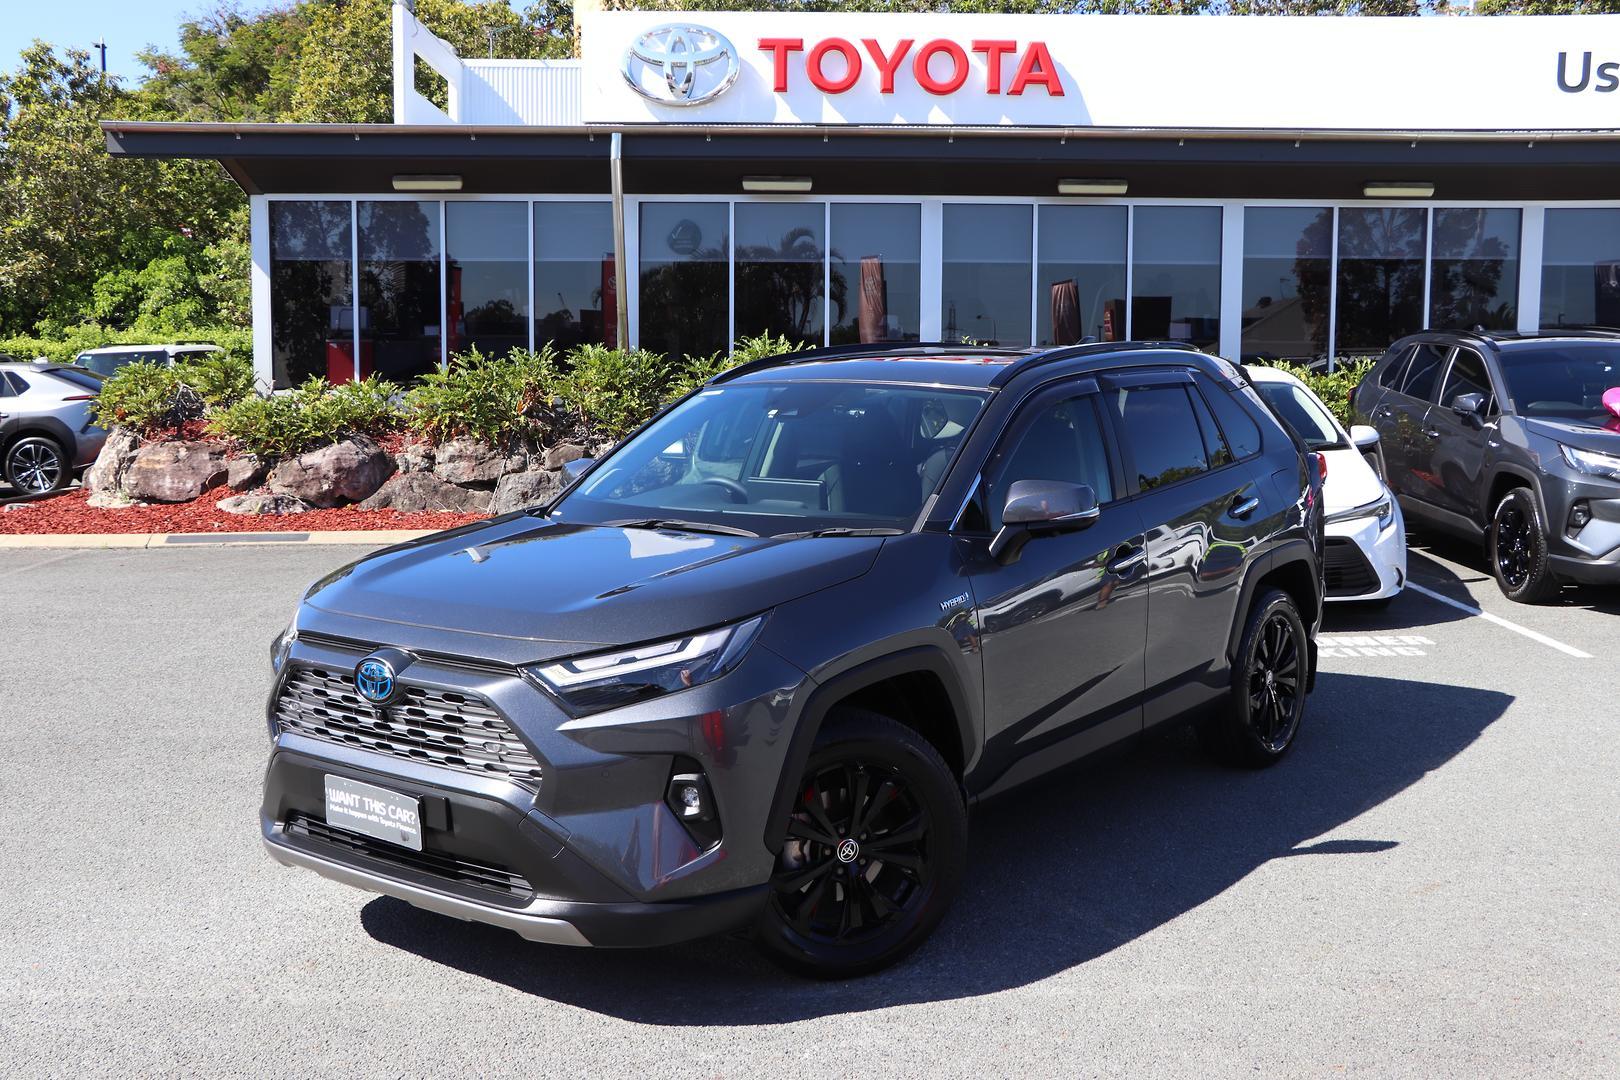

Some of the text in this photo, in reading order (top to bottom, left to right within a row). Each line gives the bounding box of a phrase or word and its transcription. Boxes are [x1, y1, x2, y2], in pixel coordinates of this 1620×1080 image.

[757, 37, 1065, 96] TOYOTA
[1557, 51, 1620, 93] Us
[940, 594, 966, 610] HYBRID
[329, 788, 415, 824] WANT THIS CAR?
[380, 817, 396, 827] Toyota
